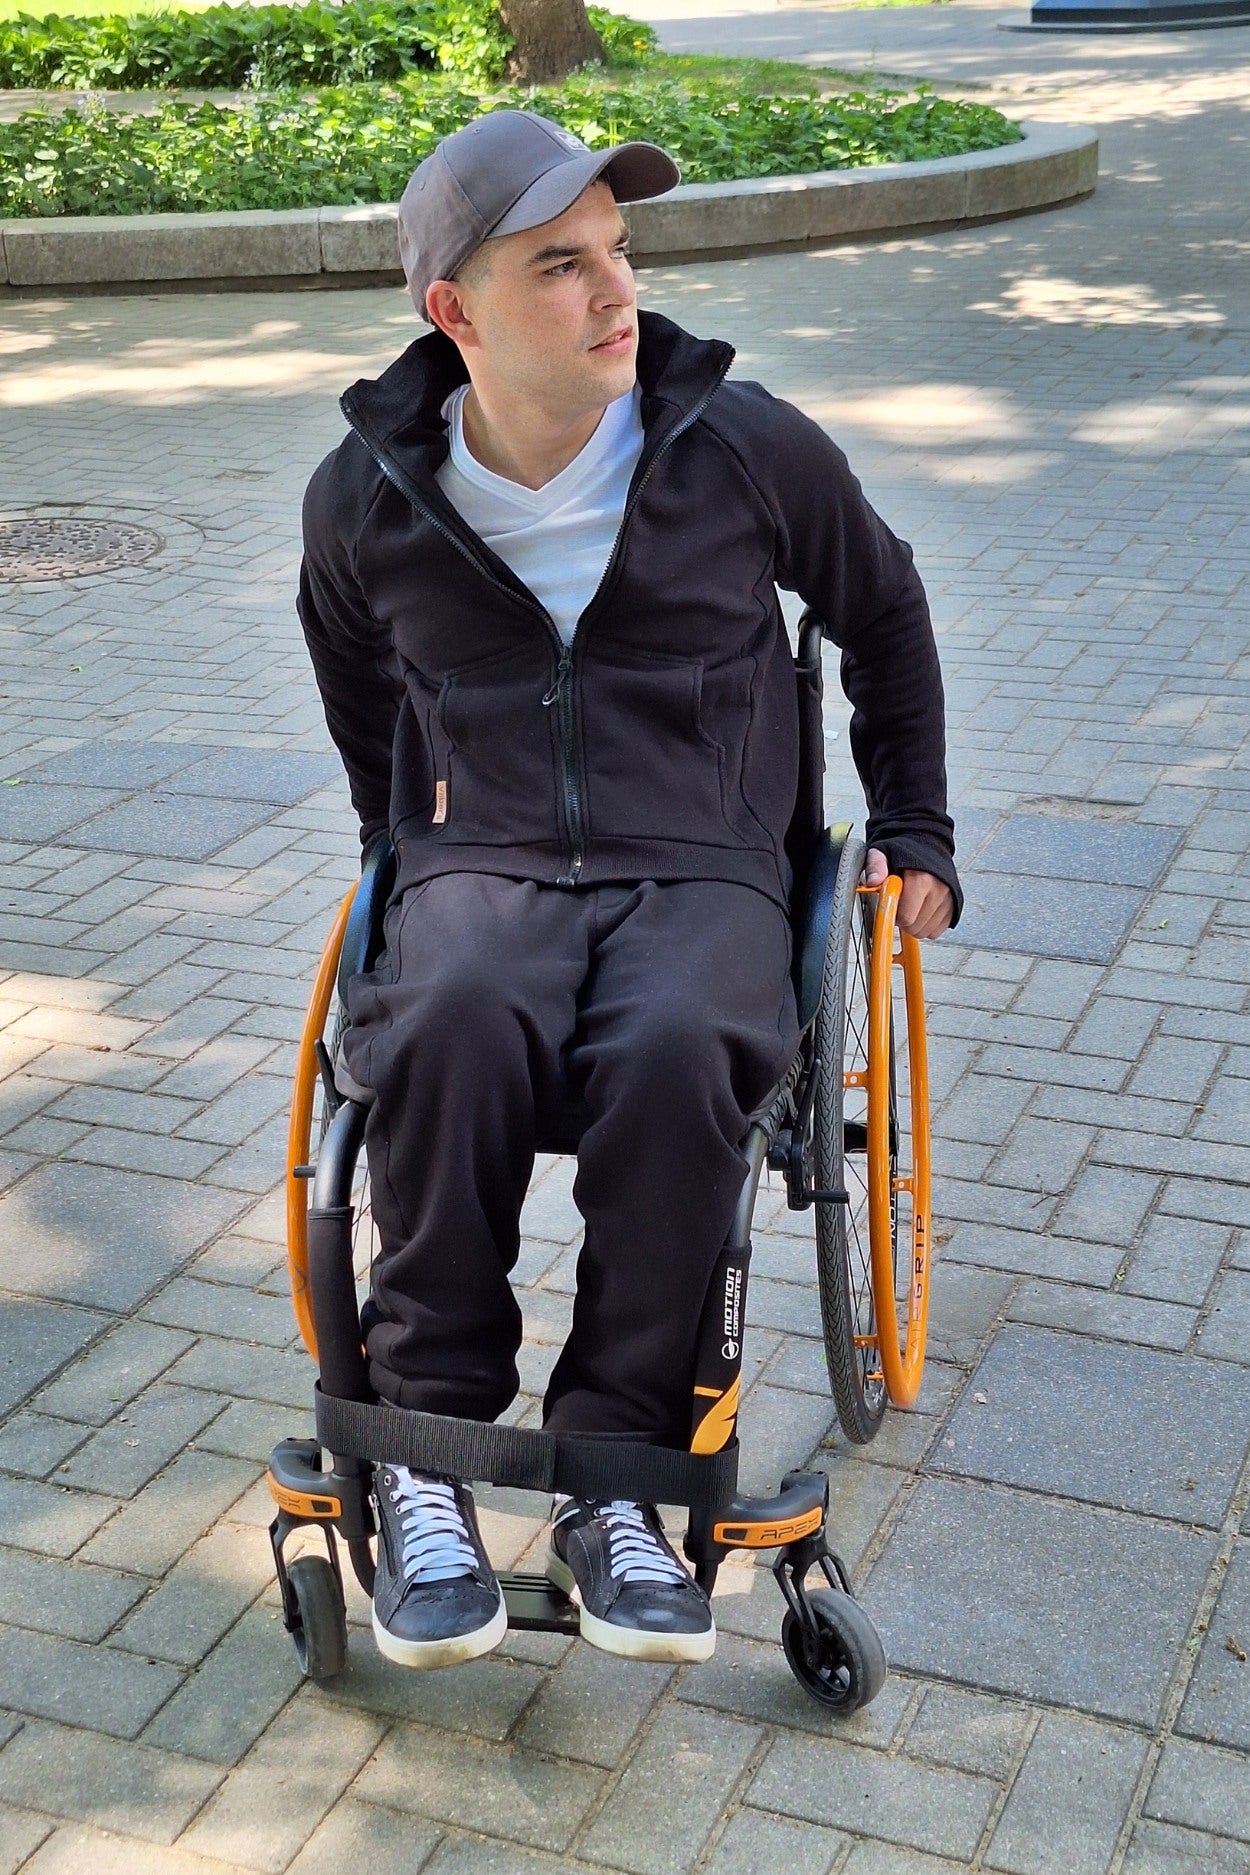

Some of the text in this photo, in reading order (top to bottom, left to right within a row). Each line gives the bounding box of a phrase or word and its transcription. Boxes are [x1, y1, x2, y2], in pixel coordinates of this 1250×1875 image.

[724, 1267, 735, 1336] MOTION
[732, 1269, 742, 1338] COMPOSITES
[760, 1516, 818, 1540] APEX
